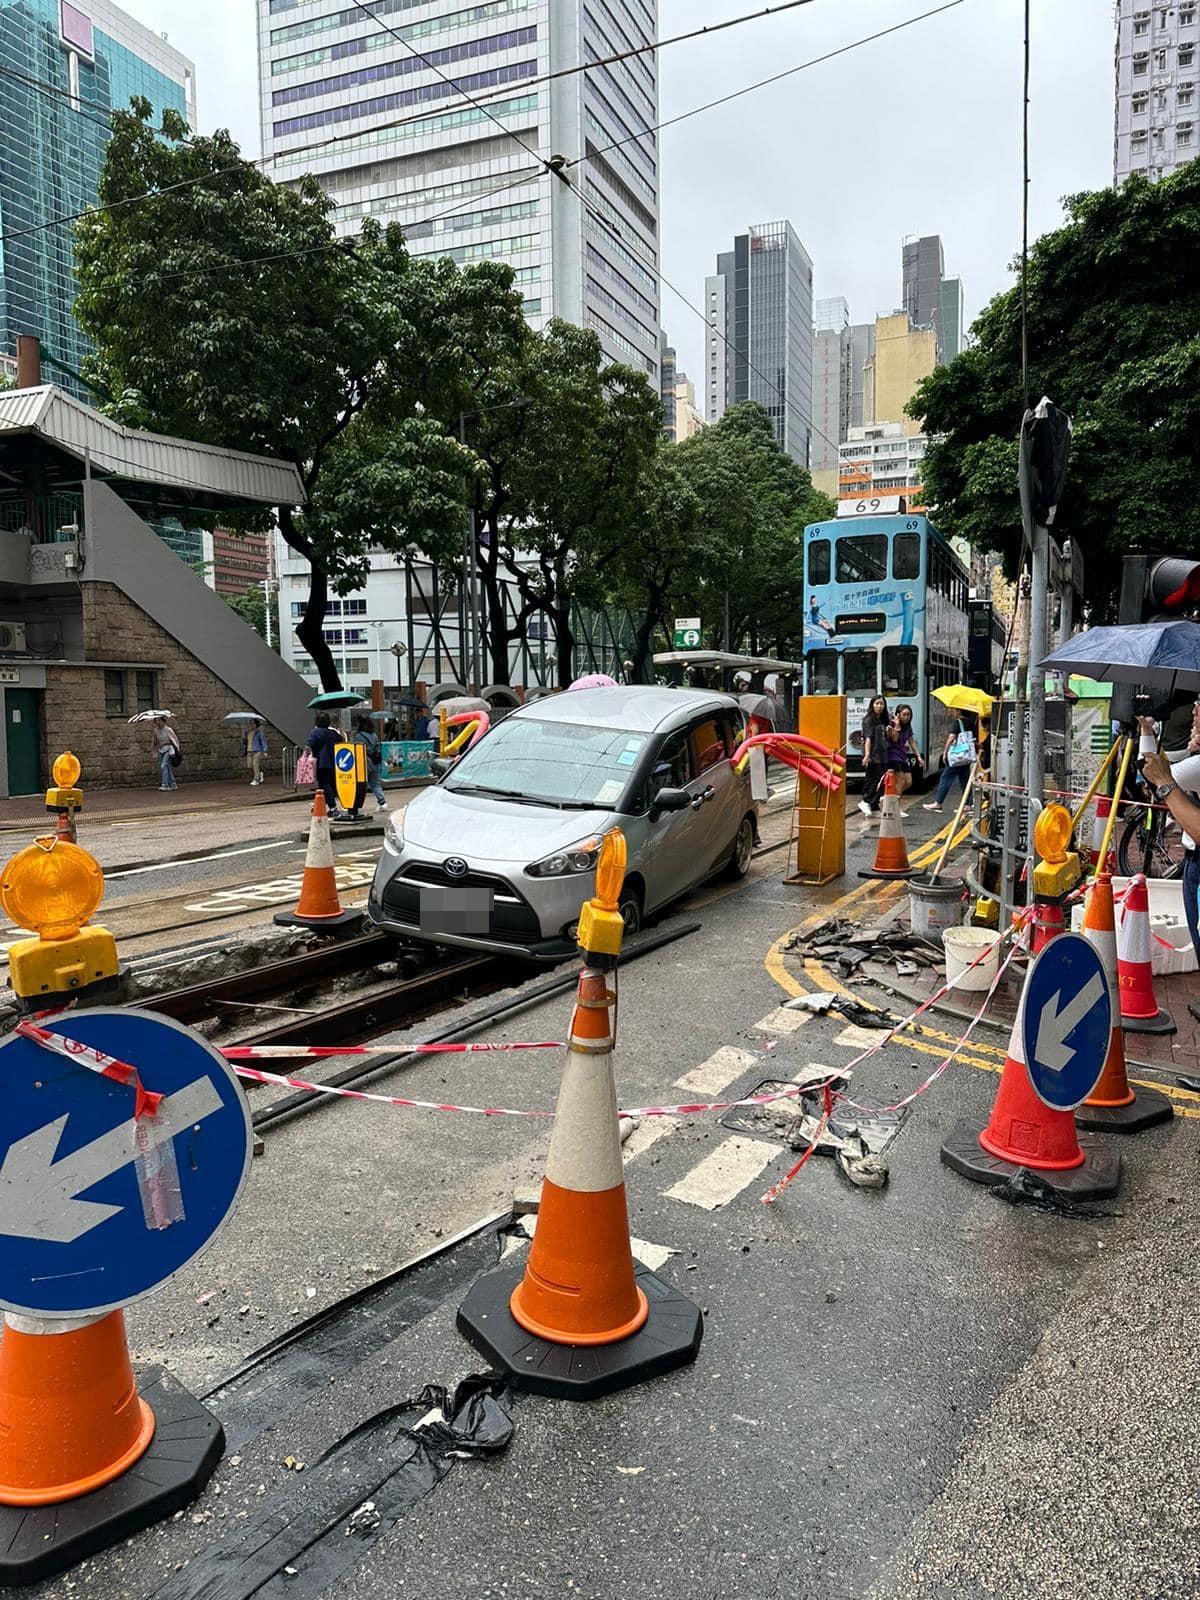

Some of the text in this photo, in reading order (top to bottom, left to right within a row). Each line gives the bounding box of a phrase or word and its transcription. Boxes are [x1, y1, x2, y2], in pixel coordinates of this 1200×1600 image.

[856, 498, 881, 513] 69
[905, 520, 918, 531] 69
[809, 527, 821, 538] 69
